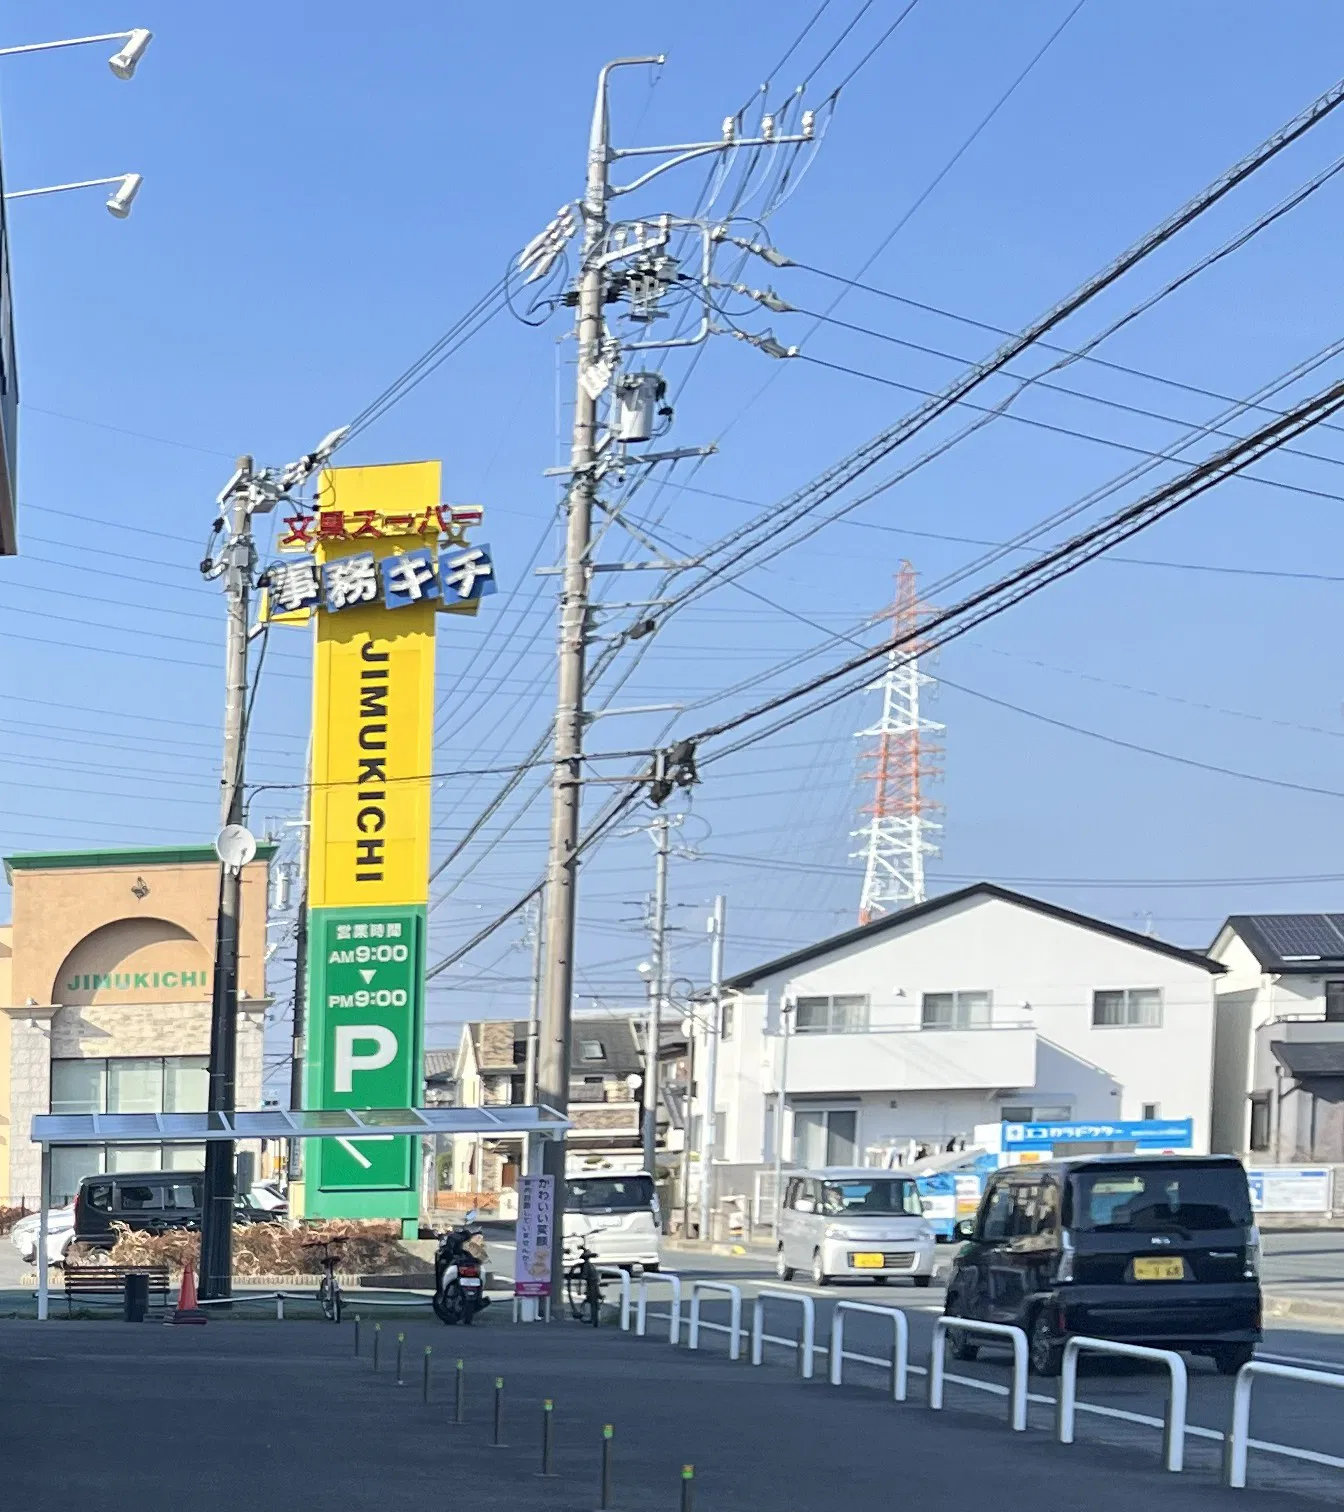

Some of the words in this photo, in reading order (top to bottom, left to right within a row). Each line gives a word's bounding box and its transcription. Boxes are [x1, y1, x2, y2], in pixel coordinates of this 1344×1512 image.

[282, 505, 483, 545] 文具スーパー
[269, 549, 492, 610] 事務キチ
[355, 640, 390, 882] JIMUKICHI
[336, 923, 402, 940] 営業時間
[328, 944, 408, 964] AM9:00
[67, 971, 208, 991] JIMUKICHI
[328, 989, 408, 1008] PM9:00
[333, 1024, 399, 1093] P
